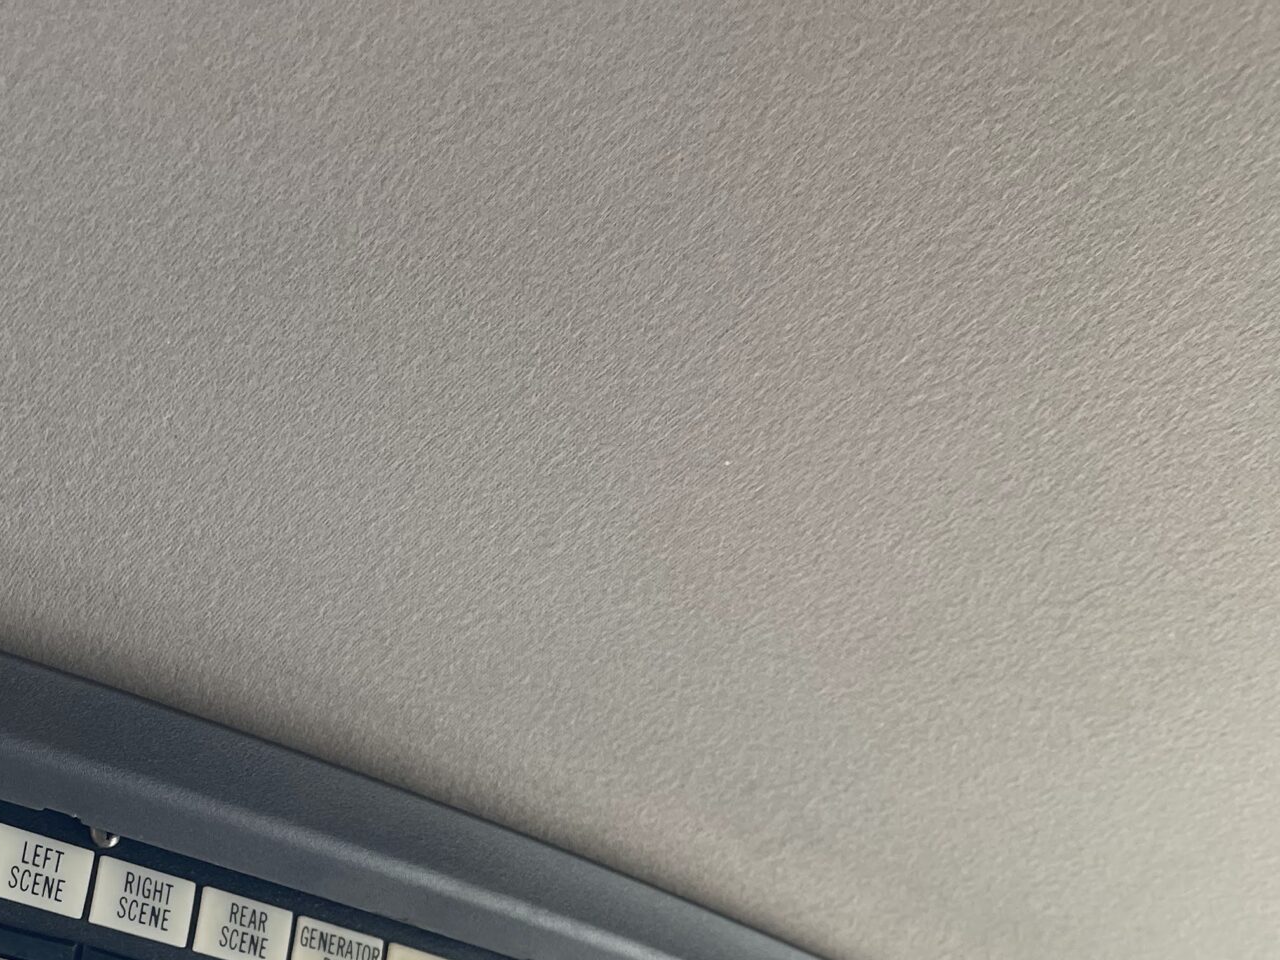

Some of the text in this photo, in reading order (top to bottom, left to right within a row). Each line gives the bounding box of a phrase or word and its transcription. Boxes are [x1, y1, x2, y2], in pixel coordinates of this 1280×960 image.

[21, 840, 65, 873] LEFT
[8, 867, 66, 902] SCENE
[124, 872, 174, 906] RIGHT
[117, 897, 172, 931] SCENE
[229, 903, 268, 933] REAR
[219, 926, 269, 959] SCENE
